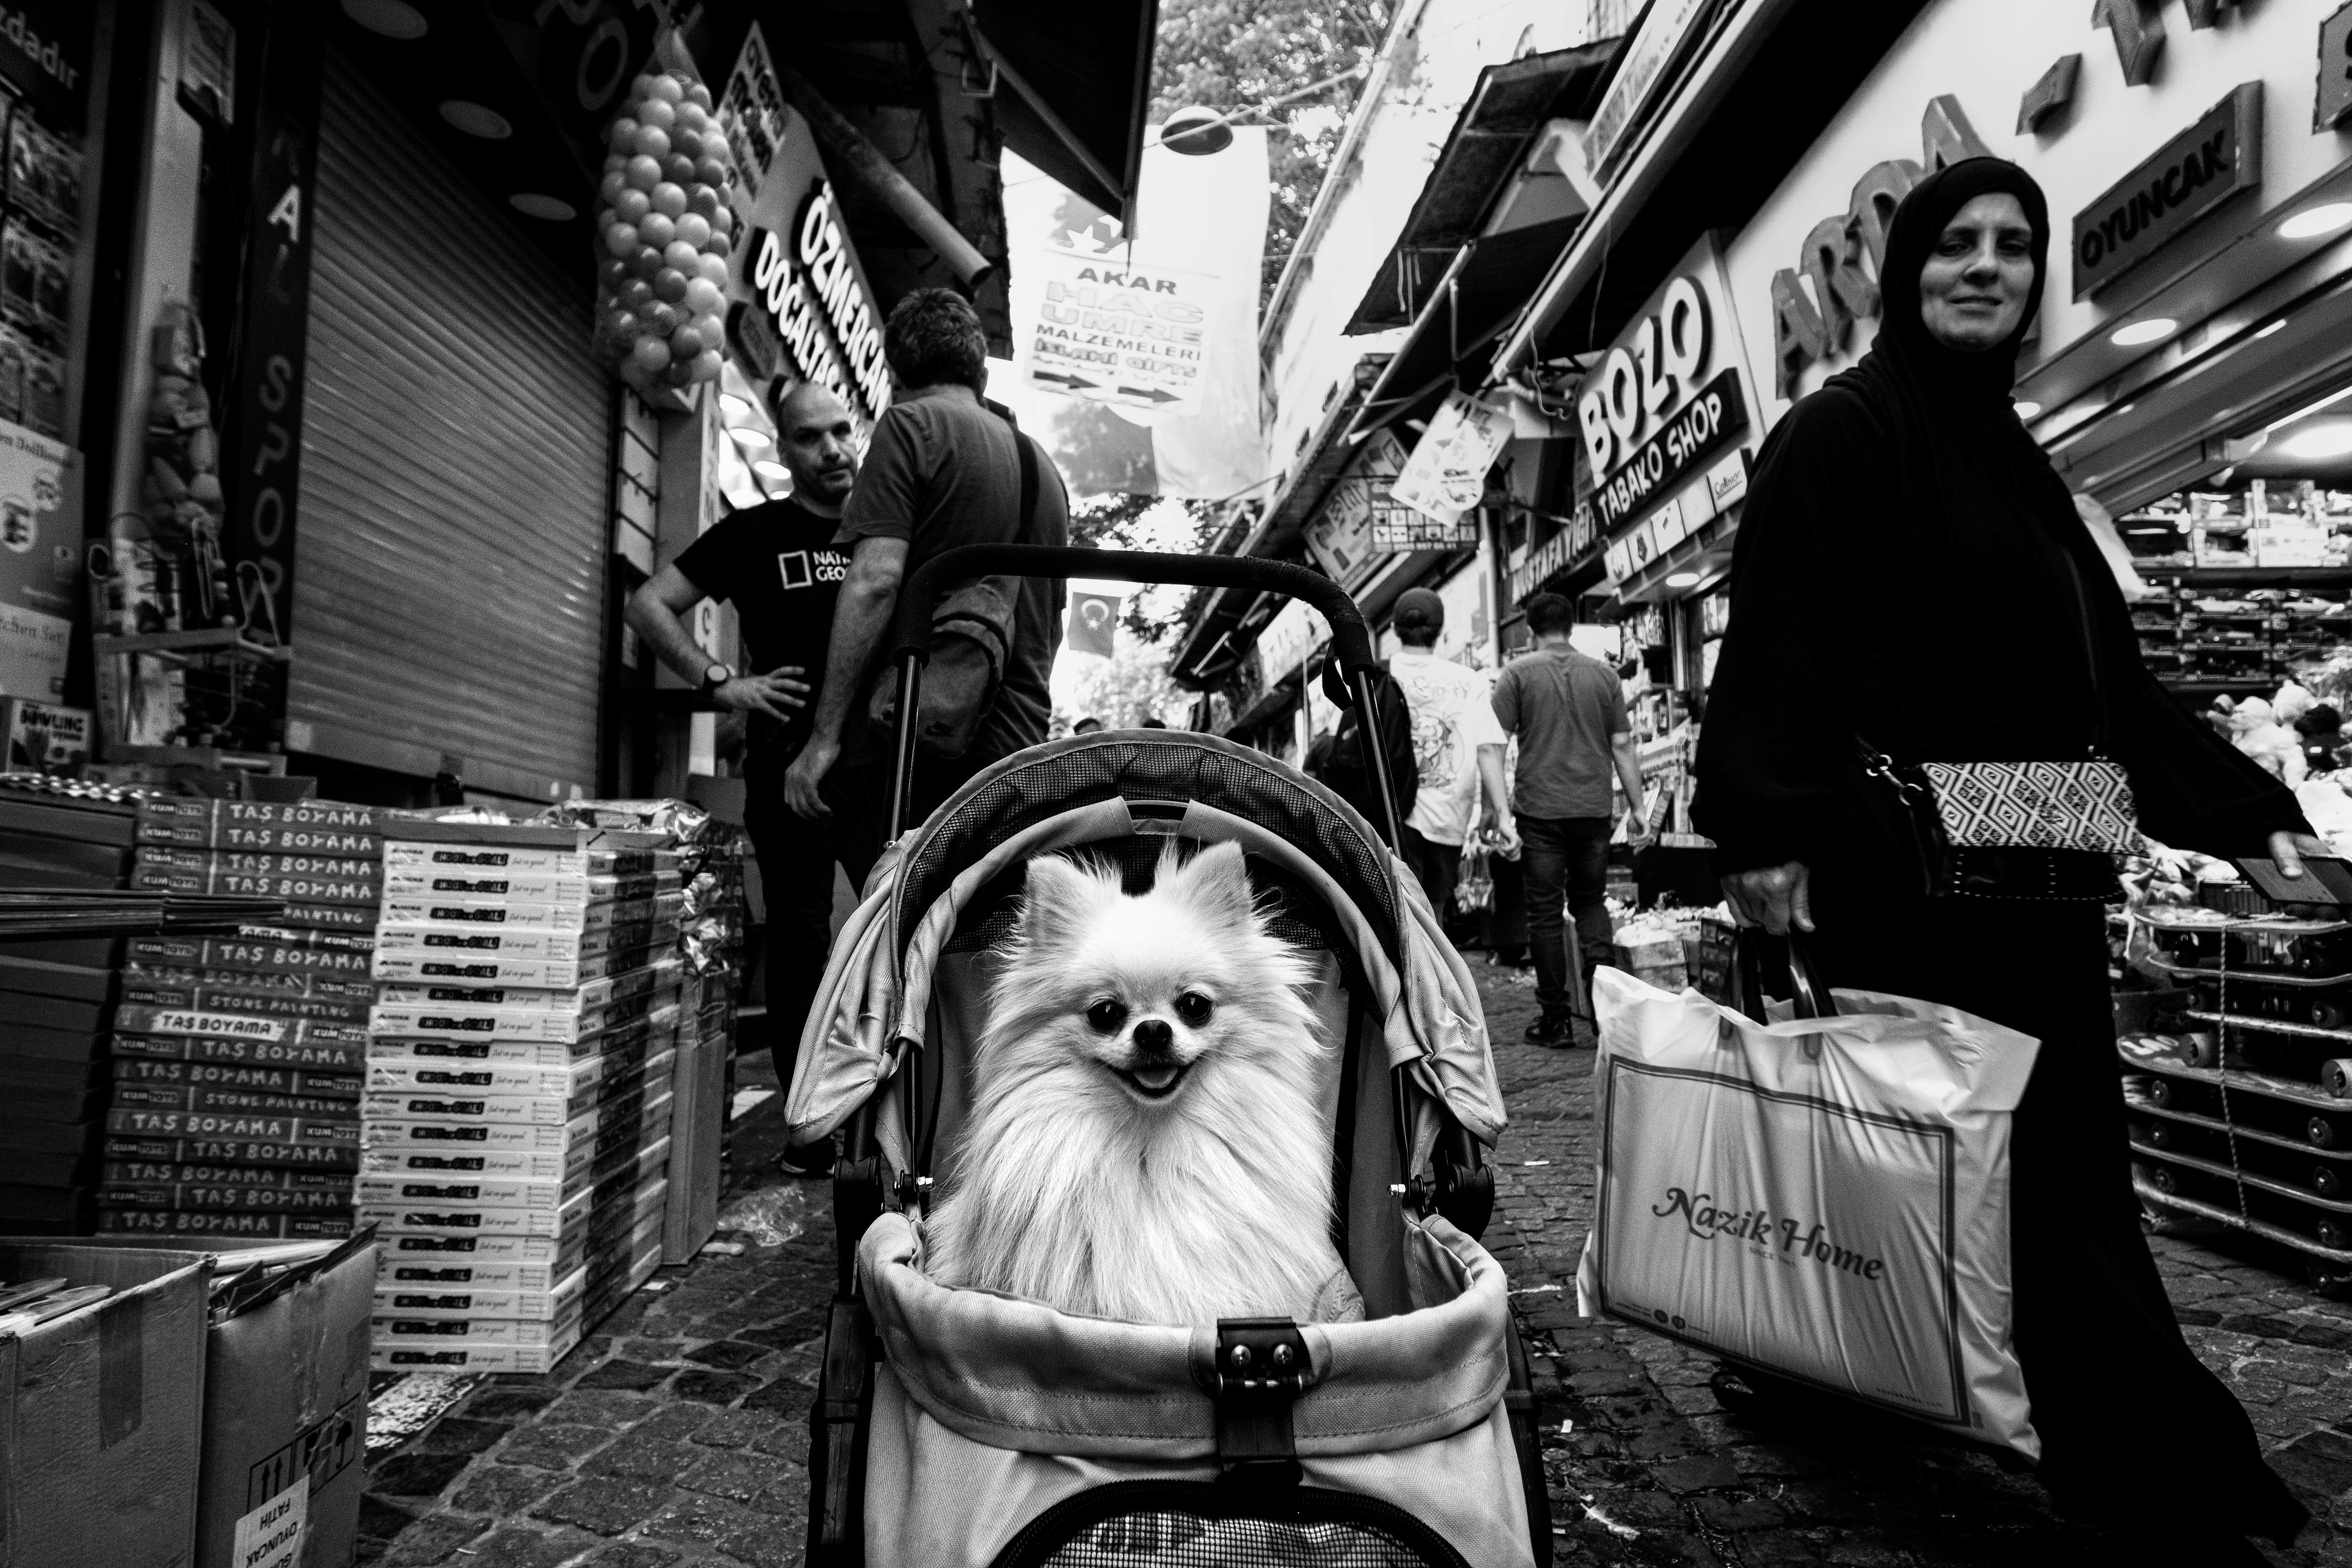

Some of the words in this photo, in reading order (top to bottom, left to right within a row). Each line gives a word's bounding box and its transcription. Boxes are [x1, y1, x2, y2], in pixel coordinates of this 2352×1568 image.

[2081, 129, 2226, 267] OYUNCAK
[1077, 268, 1177, 295] AKAR
[1046, 281, 1204, 323] HAC
[1041, 303, 1202, 346] UMRE
[1579, 277, 1703, 474] BOZO
[1597, 441, 1662, 527] TABAKO
[1667, 392, 1722, 467] SHOP
[282, 808, 372, 826] BOYAMA
[281, 832, 372, 851] BOYAMA
[280, 857, 371, 875] BOYAMA
[279, 880, 371, 899] BOYAMA
[273, 949, 366, 969] BOYAMA
[198, 1018, 271, 1035] BOYAMA
[255, 1046, 347, 1064] BOYAMA
[191, 1066, 283, 1086] BOYAMA
[187, 1116, 281, 1136] BOYAMA
[246, 1144, 338, 1162] BOYAMA
[181, 1165, 274, 1183] BOYAMA
[246, 1191, 338, 1207] BOYAMA
[176, 1214, 270, 1232] BOYAMA
[1653, 1187, 1772, 1244] Nazik
[1781, 1218, 1883, 1280] Home
[260, 1498, 291, 1530] FATİH
[246, 1521, 297, 1568] OYUNCAK
